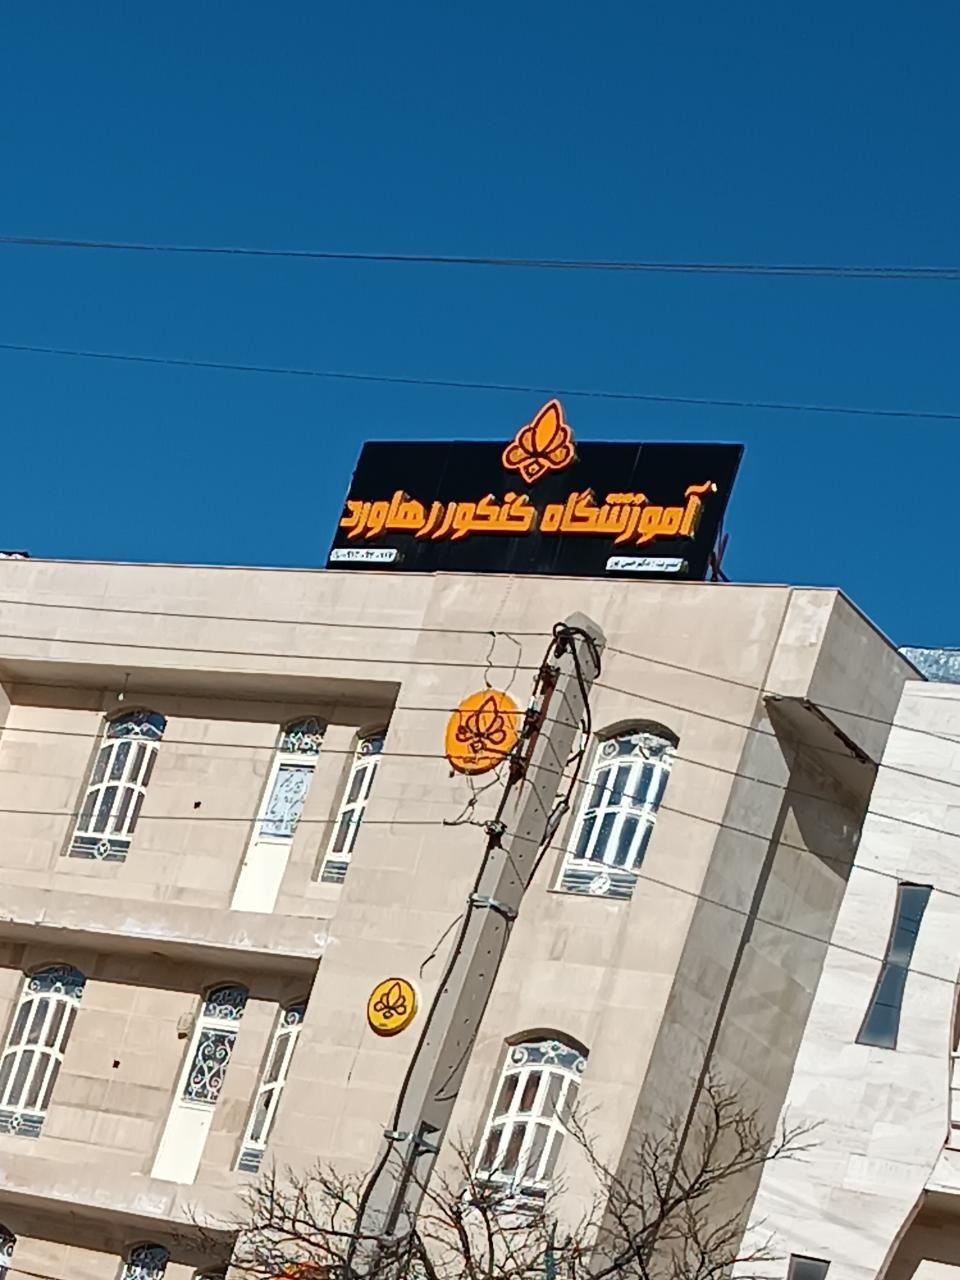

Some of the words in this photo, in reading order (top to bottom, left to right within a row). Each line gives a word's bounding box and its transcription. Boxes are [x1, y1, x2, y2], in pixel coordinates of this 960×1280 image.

[339, 490, 442, 540] رهاورد
[431, 491, 536, 541] کنکور
[541, 479, 718, 545] آموزشگاه
